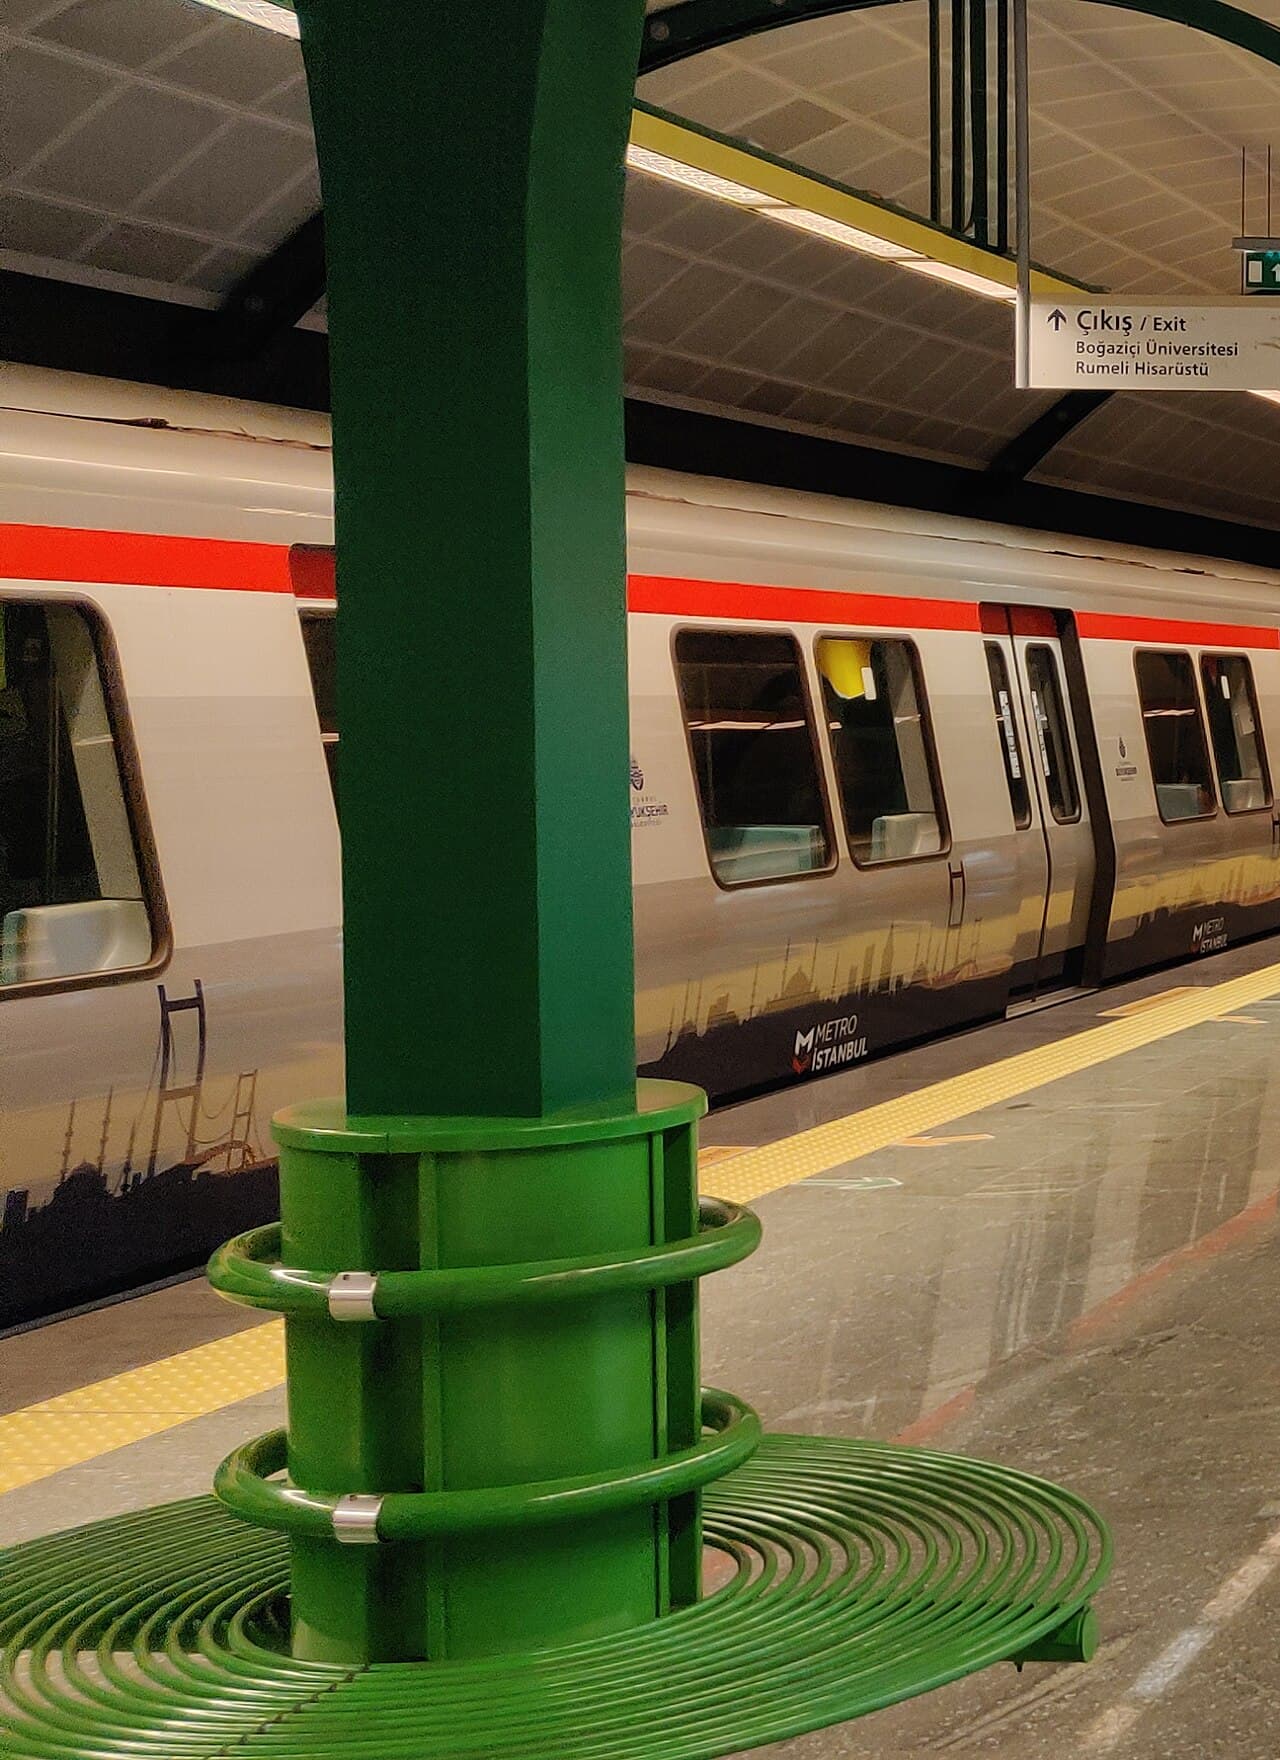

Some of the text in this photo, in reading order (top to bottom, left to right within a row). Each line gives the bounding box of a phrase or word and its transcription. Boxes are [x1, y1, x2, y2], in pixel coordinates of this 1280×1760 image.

[1077, 309, 1187, 336] Çıkış / Exit
[1076, 339, 1238, 358] Boğaziçi Üniversitesi
[1076, 361, 1209, 376] Rumeli Hisarüstü
[795, 1027, 815, 1056] M
[815, 1014, 858, 1045] METRO
